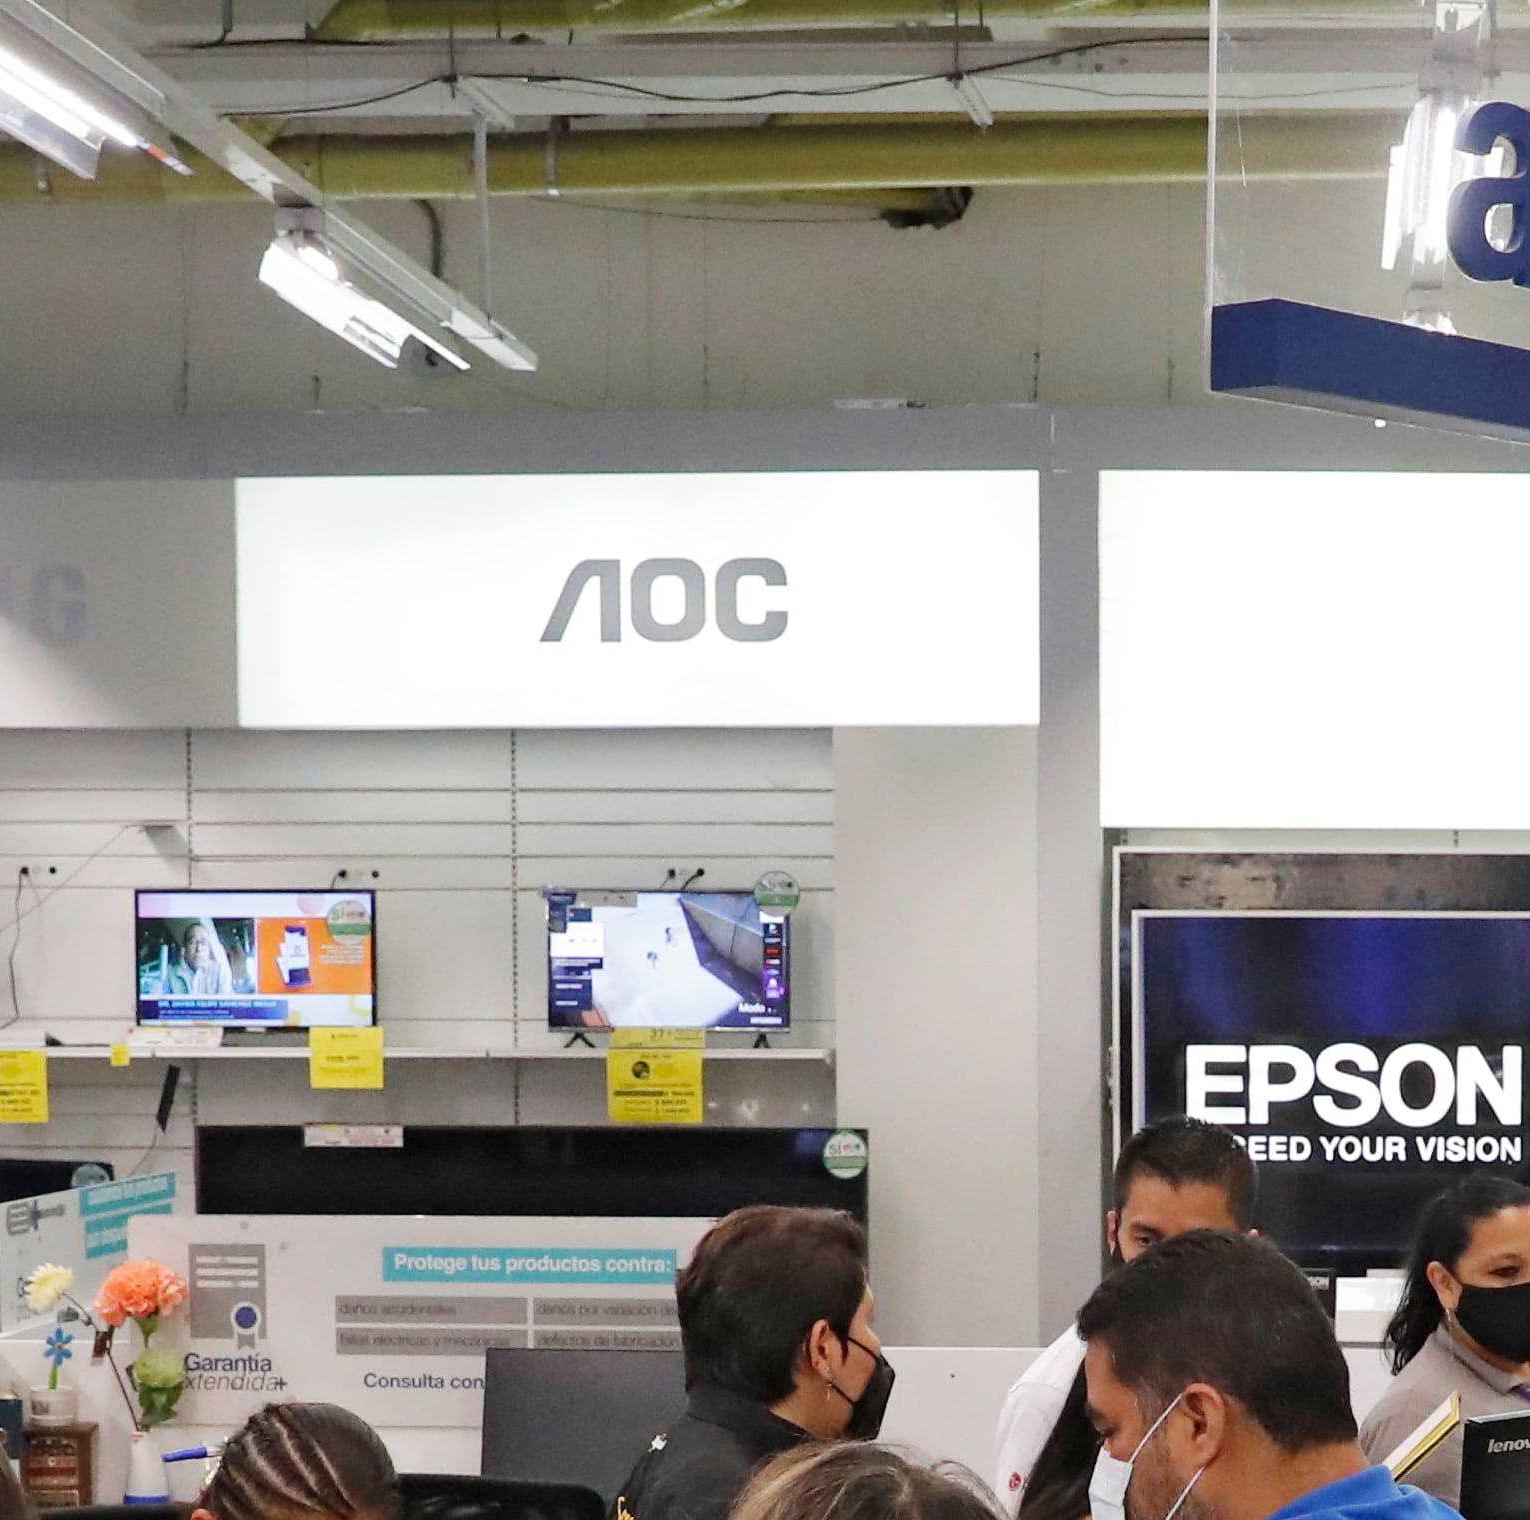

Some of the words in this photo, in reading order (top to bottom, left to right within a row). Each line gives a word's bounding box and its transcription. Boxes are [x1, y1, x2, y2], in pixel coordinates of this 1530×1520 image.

[539, 556, 789, 643] AOC
[1185, 1042, 1522, 1127] EPSON
[1319, 1136, 1406, 1162] YOUR
[1416, 1136, 1522, 1162] VISION
[393, 1253, 468, 1275] Protege
[471, 1255, 501, 1272] tus
[505, 1255, 601, 1275] productos
[605, 1255, 672, 1273] contra:
[183, 1352, 272, 1373] Garantía
[363, 1372, 444, 1390] Consulta
